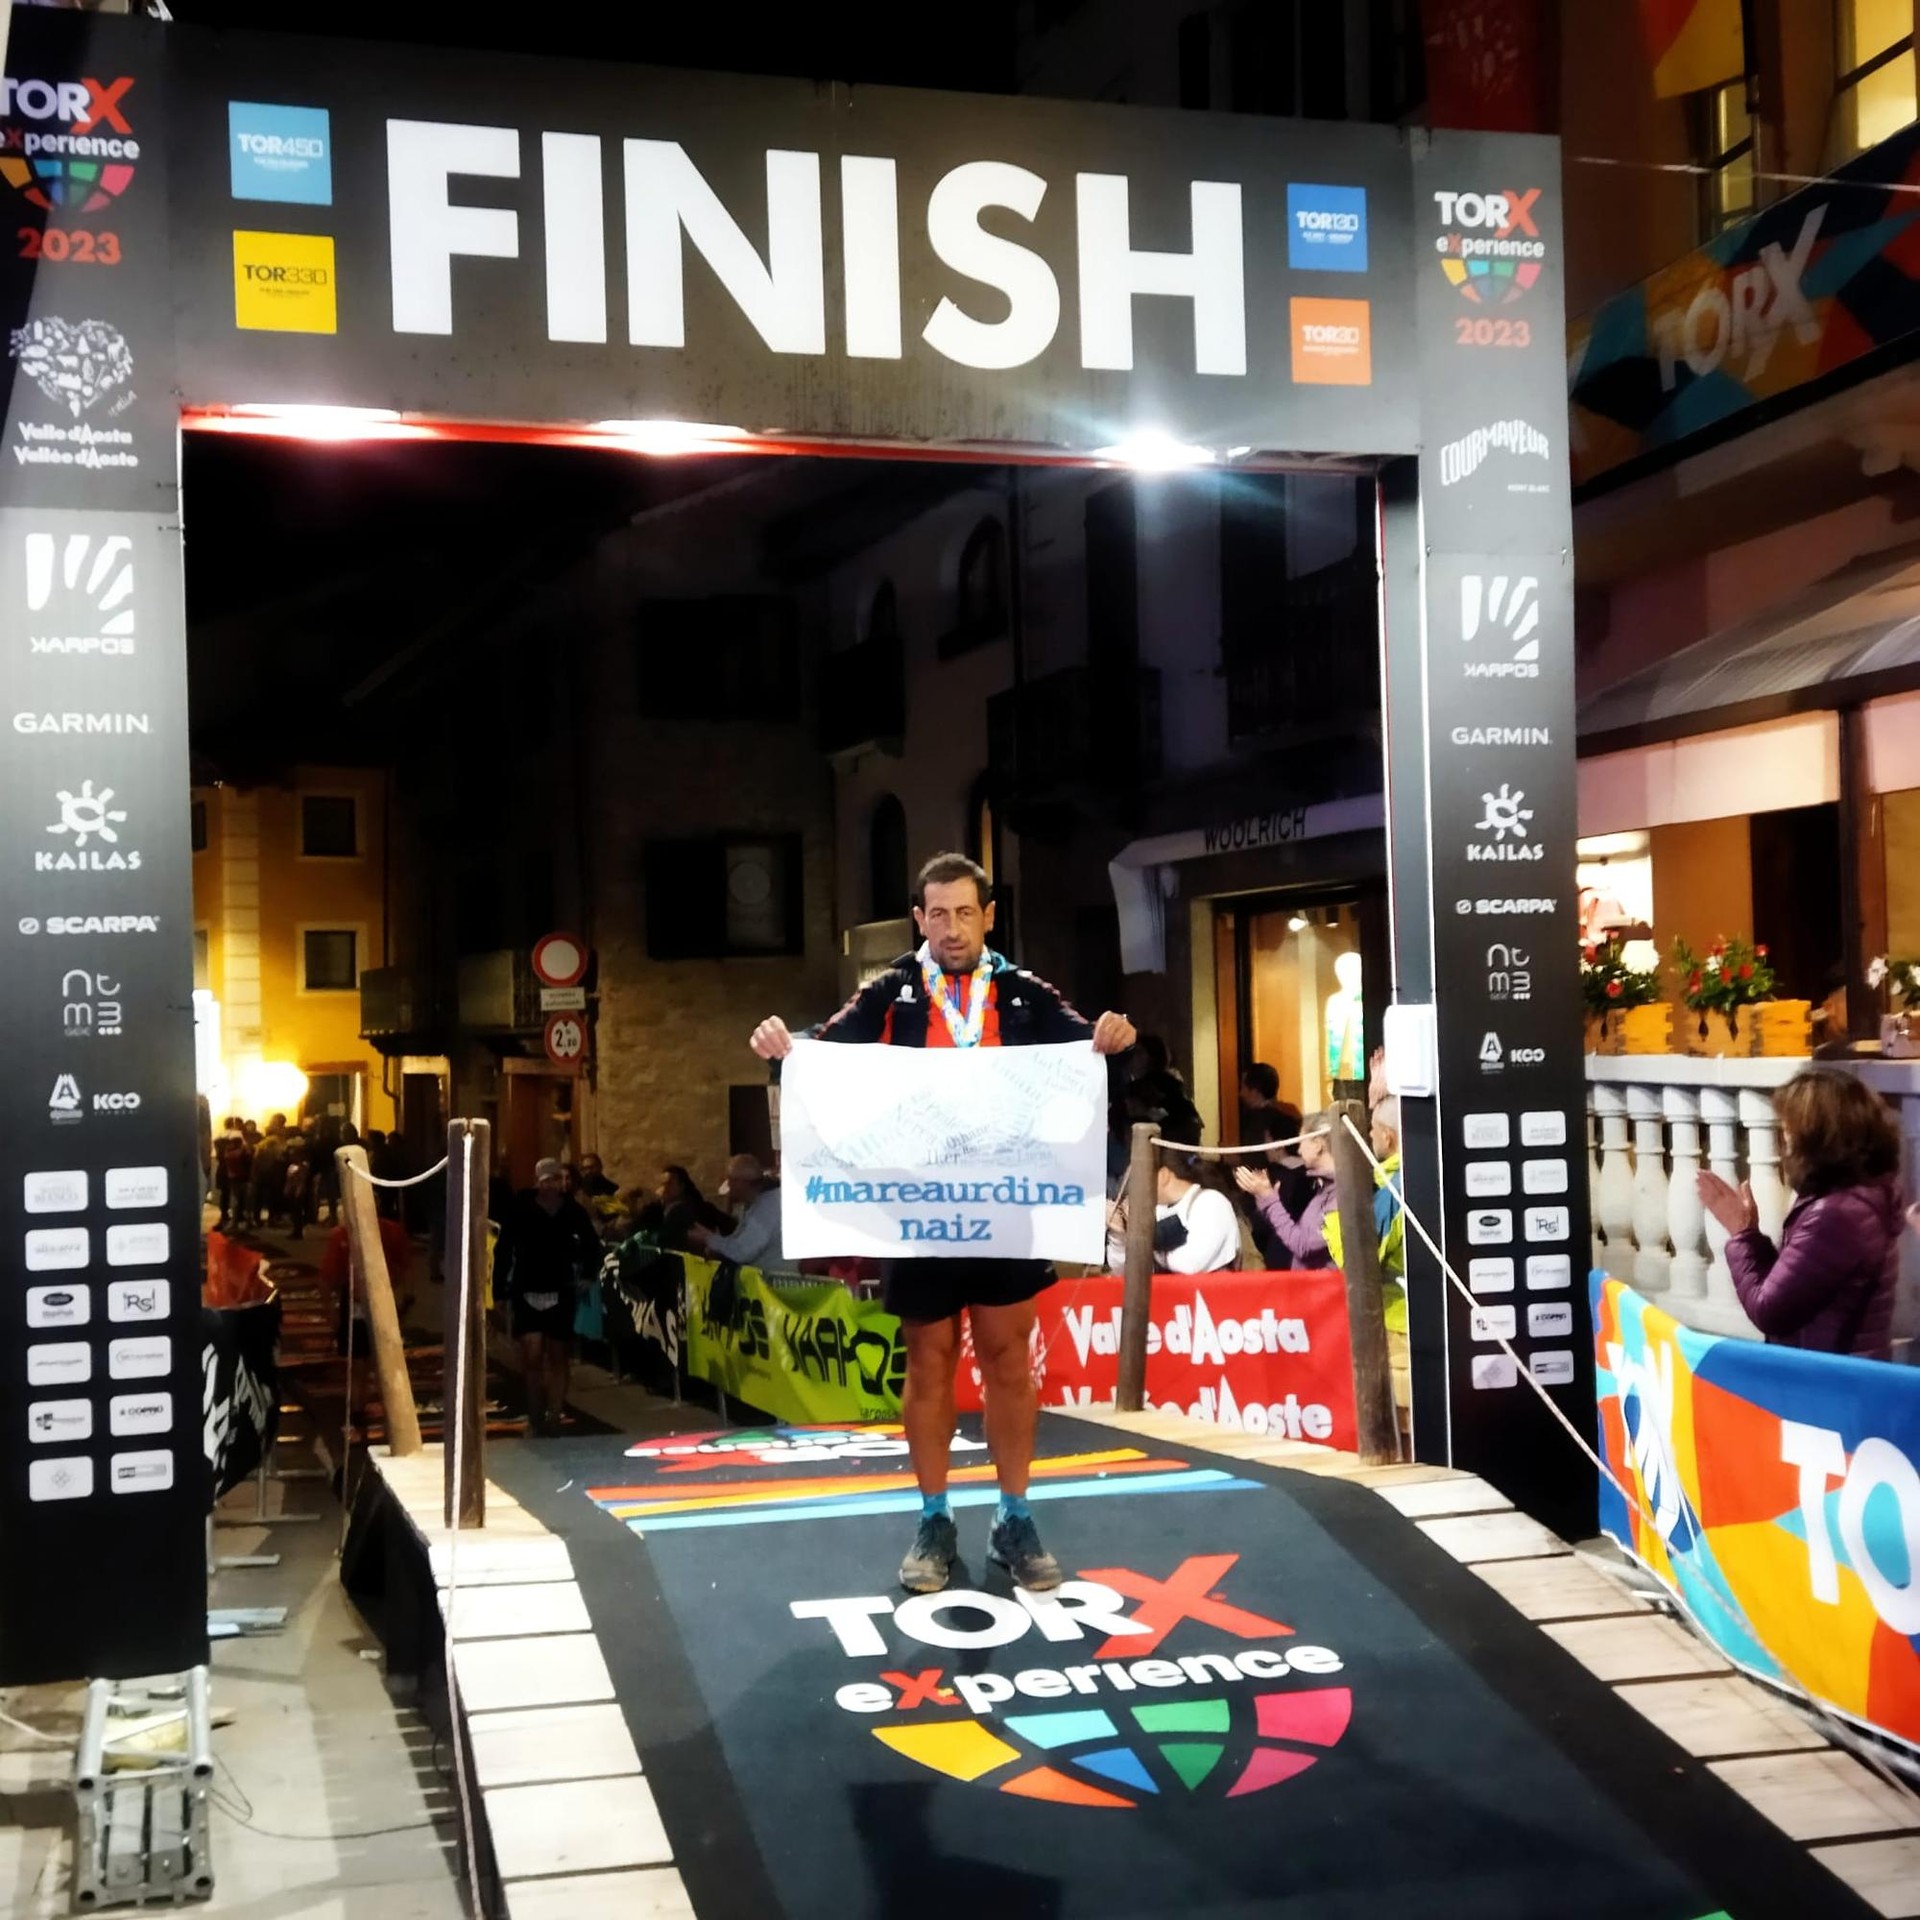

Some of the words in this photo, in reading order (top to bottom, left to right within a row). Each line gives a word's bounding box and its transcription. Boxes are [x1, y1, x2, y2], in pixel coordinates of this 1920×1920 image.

[1, 77, 135, 134] TORX
[1434, 188, 1542, 237] TORX
[17, 227, 122, 265] 2023
[386, 118, 1247, 376] FINISH
[243, 264, 327, 285] TOR330
[1652, 202, 1830, 393] TORX
[1456, 317, 1531, 347] 2023
[1441, 419, 1549, 486] COURMAYEUR
[13, 712, 149, 734] GARMIN
[1451, 726, 1549, 745] GARMIN
[1204, 807, 1307, 852] WOOLRICH
[35, 851, 141, 871] KAILAS
[1466, 843, 1544, 861] KAILAS
[805, 1175, 1085, 1207] #mareaurdina
[899, 1213, 993, 1242] naiz
[1062, 1304, 1162, 1368] Vale
[1165, 1289, 1311, 1365] d'Aosta
[790, 1553, 1296, 1660] TORX
